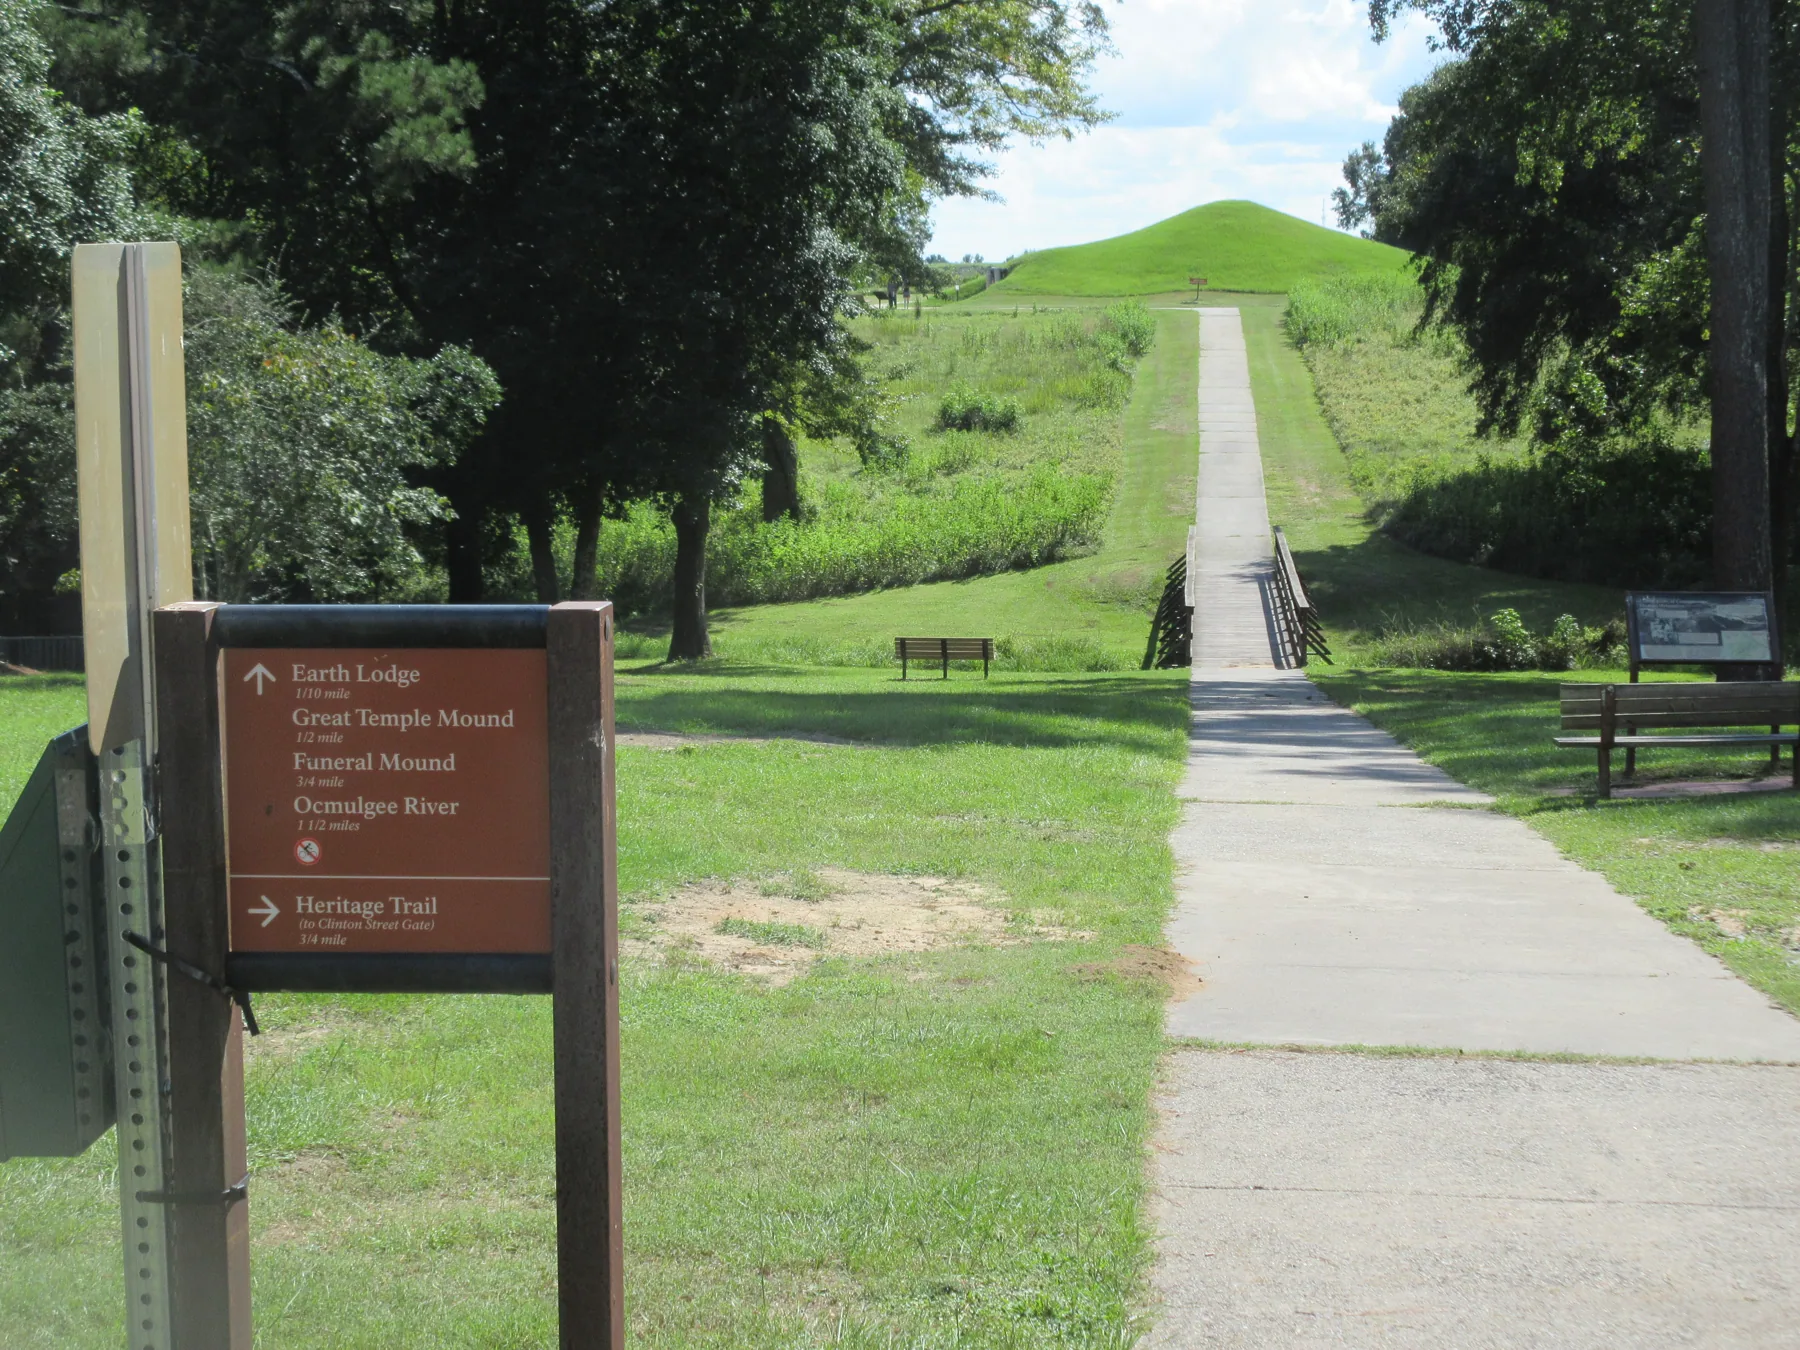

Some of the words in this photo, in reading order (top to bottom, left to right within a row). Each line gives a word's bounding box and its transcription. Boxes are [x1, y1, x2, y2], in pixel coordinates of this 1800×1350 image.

[292, 664, 350, 682] Earth
[357, 665, 420, 687] Lodge
[296, 688, 322, 699] 1/10
[324, 688, 350, 699] mile
[293, 709, 351, 727] Great
[356, 709, 431, 731] Temple
[438, 709, 514, 727] Mound
[296, 732, 315, 743] 1/2
[317, 732, 343, 743] mile
[293, 753, 372, 771] Funeral
[380, 754, 455, 771] Mound
[296, 776, 315, 787] 3/4
[319, 776, 344, 787] mile
[294, 797, 398, 819] Ocmulgee
[404, 798, 459, 815] River
[308, 820, 327, 831] 1/2
[329, 820, 360, 831] miles
[296, 897, 384, 918] Heritage
[389, 897, 438, 914] Trail
[299, 919, 315, 930] (to
[318, 919, 362, 930] Clinton
[365, 919, 399, 930] Street
[402, 919, 435, 931] Gate)
[300, 933, 318, 945] 3/4
[321, 934, 346, 945] mile
